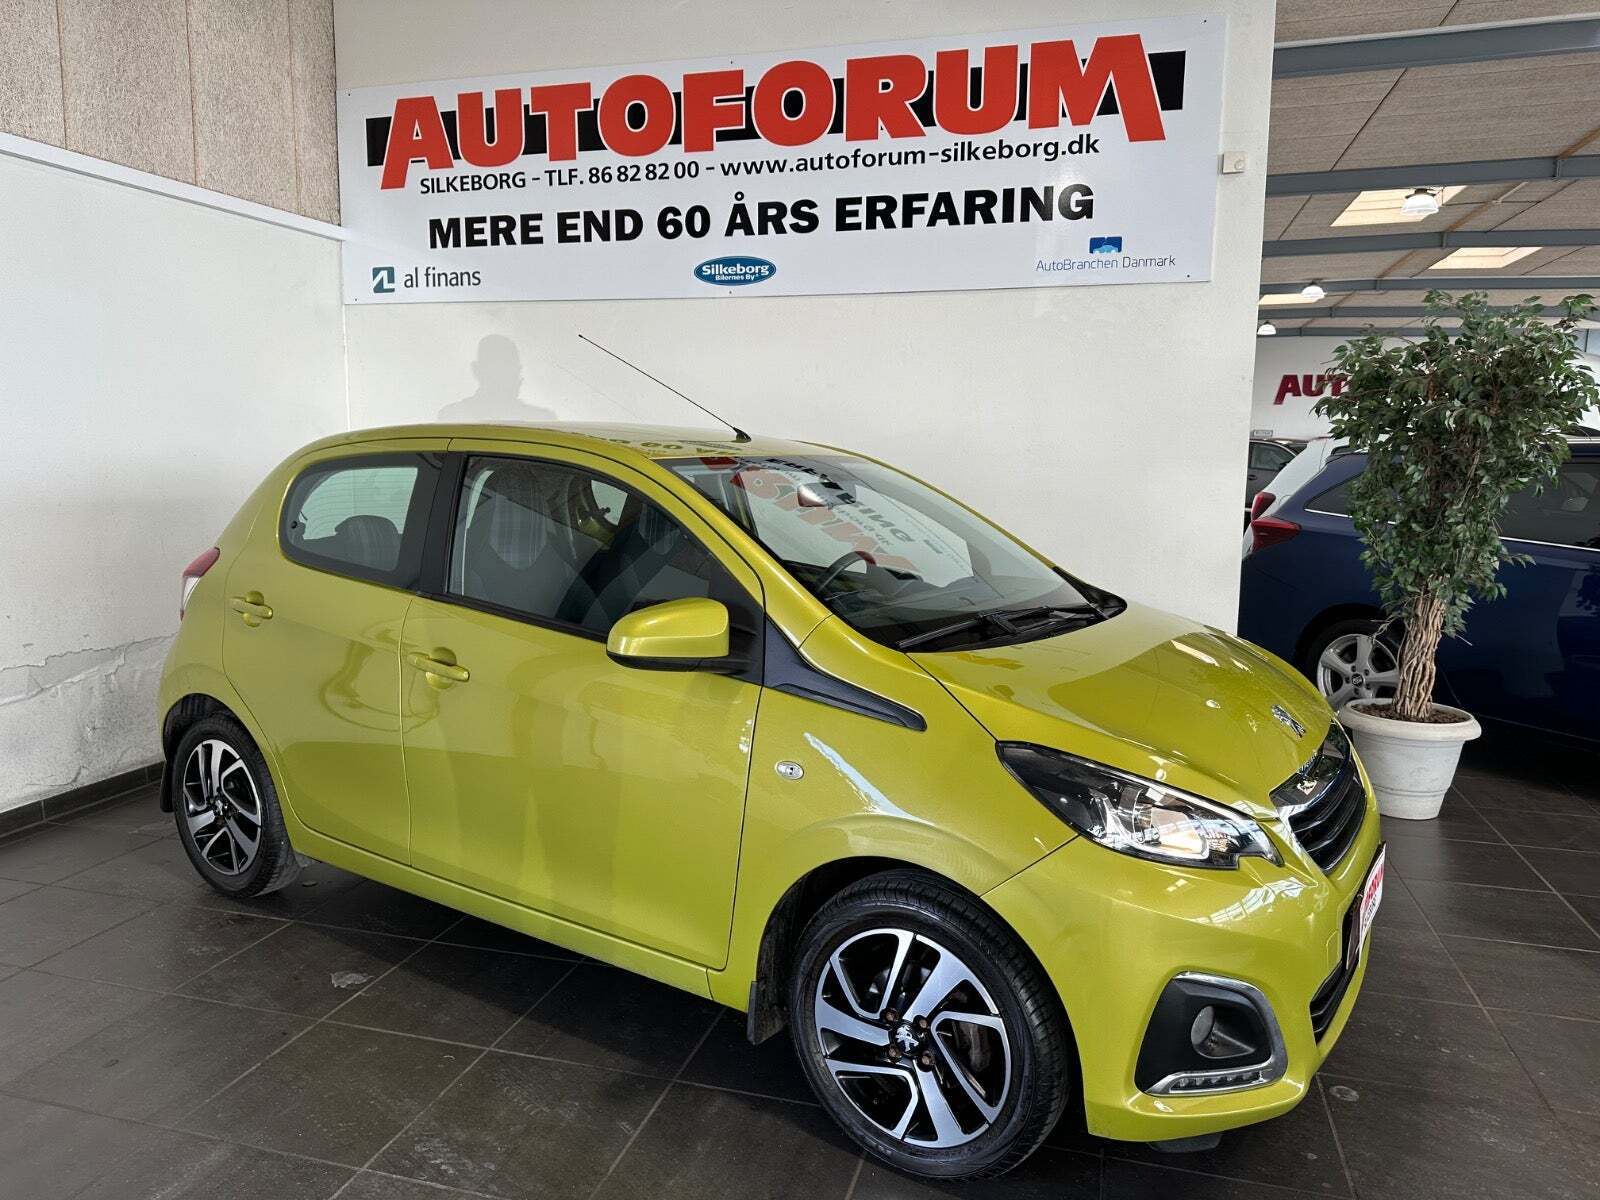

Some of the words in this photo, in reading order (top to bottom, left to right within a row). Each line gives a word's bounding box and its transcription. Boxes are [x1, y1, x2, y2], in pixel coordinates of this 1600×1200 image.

[381, 34, 1166, 191] AUTOFORUM
[420, 171, 526, 194] SILKEBORG
[544, 168, 584, 187] TLF.
[588, 166, 613, 185] 86
[616, 164, 642, 183] 82
[645, 162, 670, 181] 82
[673, 160, 700, 179] 00
[720, 133, 1100, 176] www.autoforum-silkeborg.dk
[429, 212, 544, 249] MERE
[556, 208, 644, 244] END
[657, 204, 711, 240] 60
[724, 191, 819, 237] ÅRS
[835, 183, 1095, 232] ERFARING
[404, 266, 419, 288] al
[424, 266, 481, 287] finans
[702, 263, 769, 276] Silkeborg
[1036, 258, 1118, 272] AutoBranchen
[1122, 255, 1176, 268] Danmark
